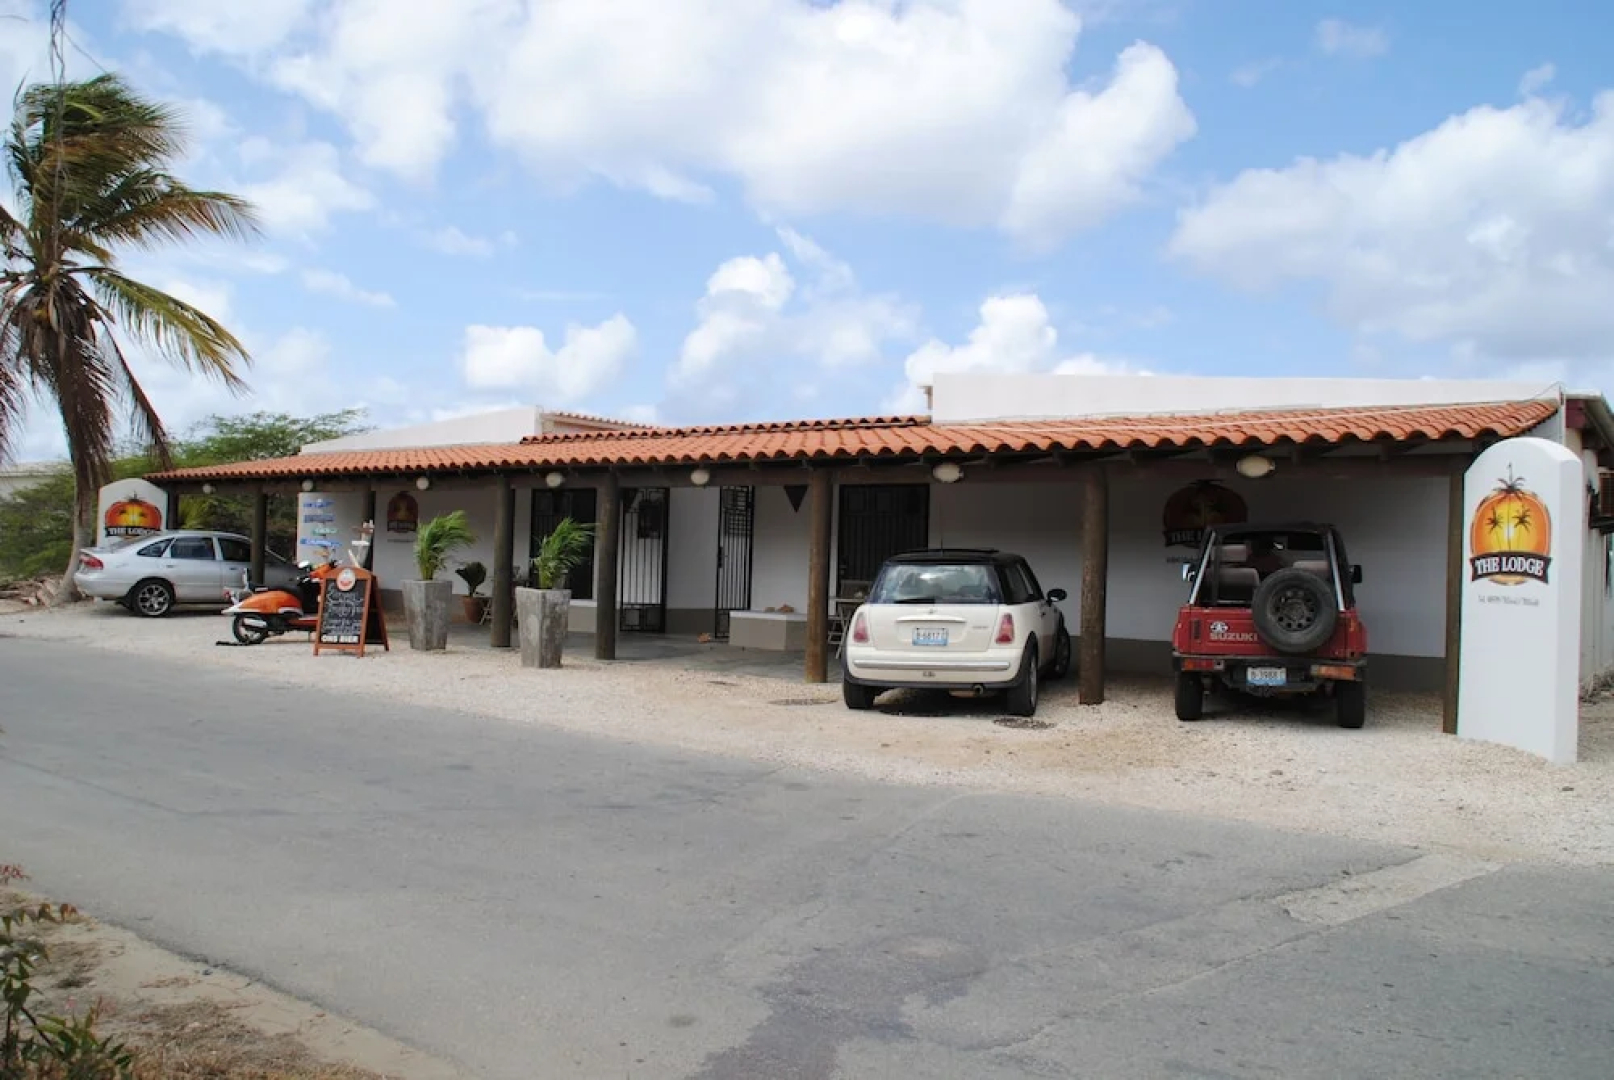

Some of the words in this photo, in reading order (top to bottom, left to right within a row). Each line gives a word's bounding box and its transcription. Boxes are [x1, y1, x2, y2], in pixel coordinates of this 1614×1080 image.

[1475, 556, 1500, 575] THE
[1501, 556, 1544, 576] LODGE
[1209, 632, 1258, 642] SUZUKI
